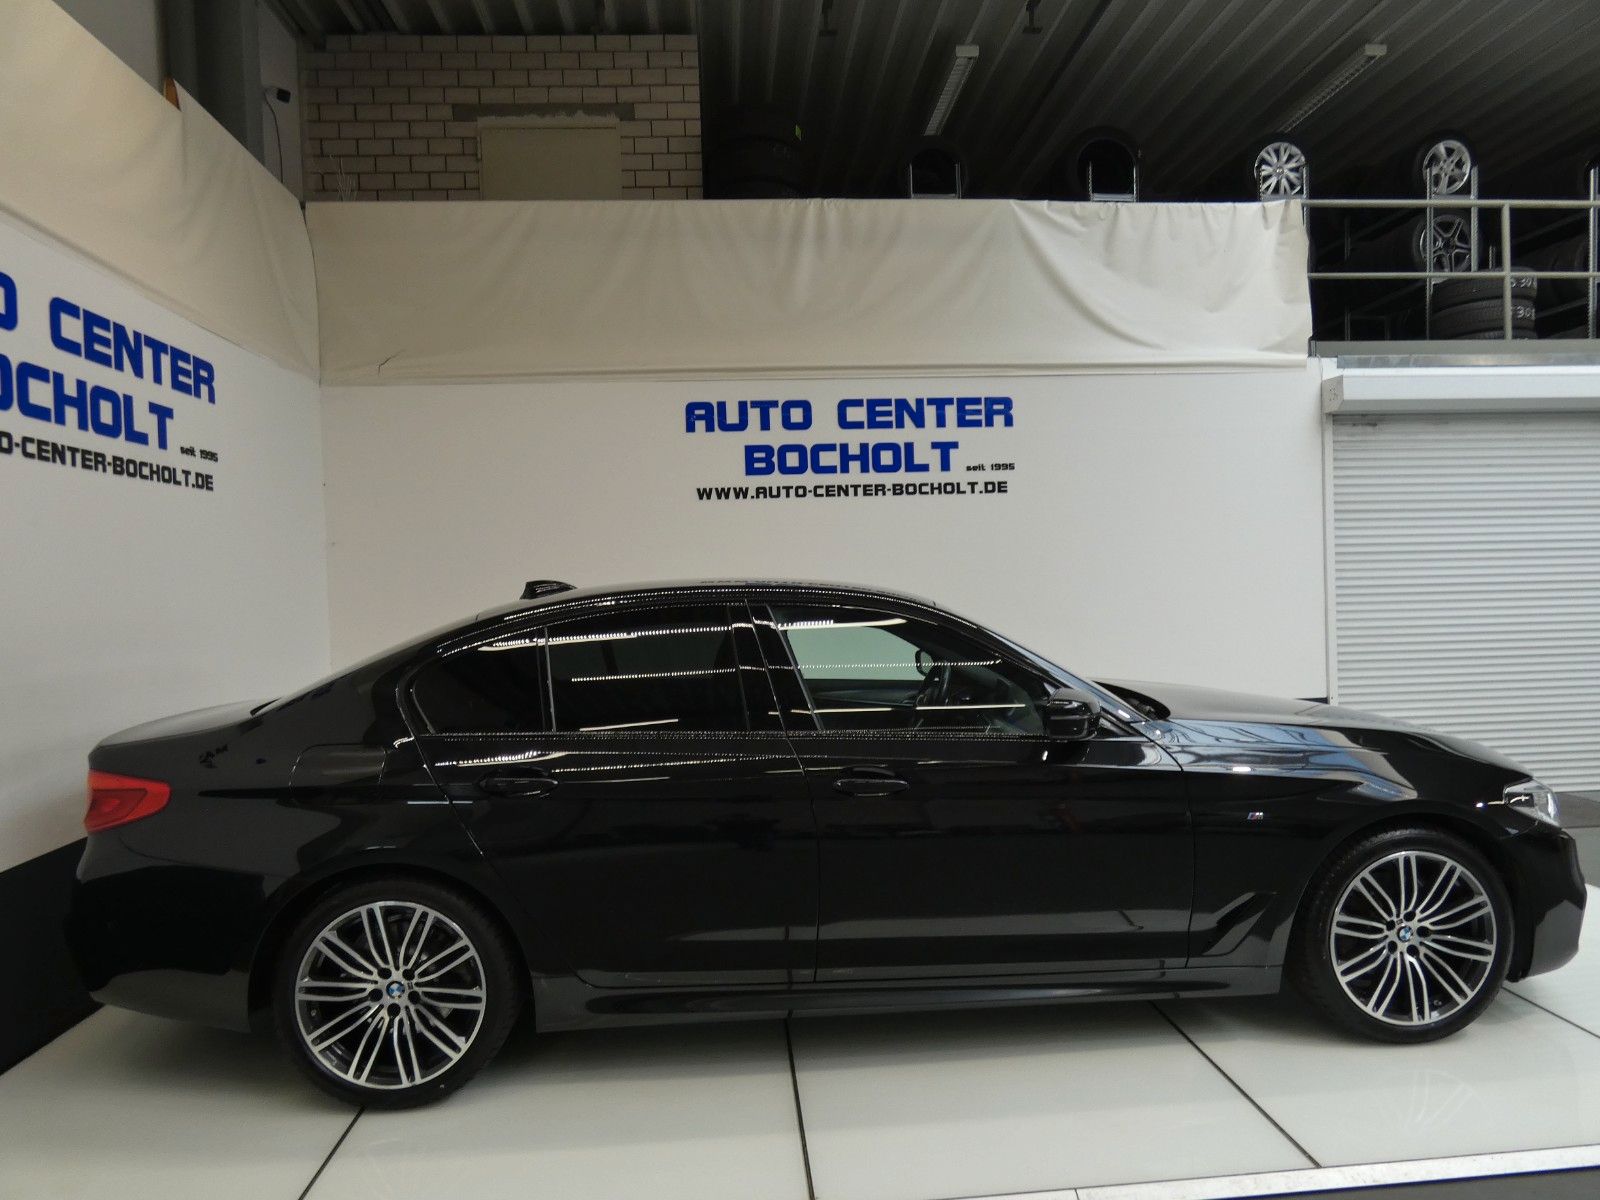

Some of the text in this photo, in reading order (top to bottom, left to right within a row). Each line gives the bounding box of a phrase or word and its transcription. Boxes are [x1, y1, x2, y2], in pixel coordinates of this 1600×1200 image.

[49, 297, 215, 404] CENTER
[685, 397, 1014, 433] AUTO CENTER
[744, 441, 959, 476] BOCHOLT
[991, 463, 1015, 471] 1995
[696, 481, 1008, 500] WWW.AUTO-CENTER-BOCHOLT.DE
